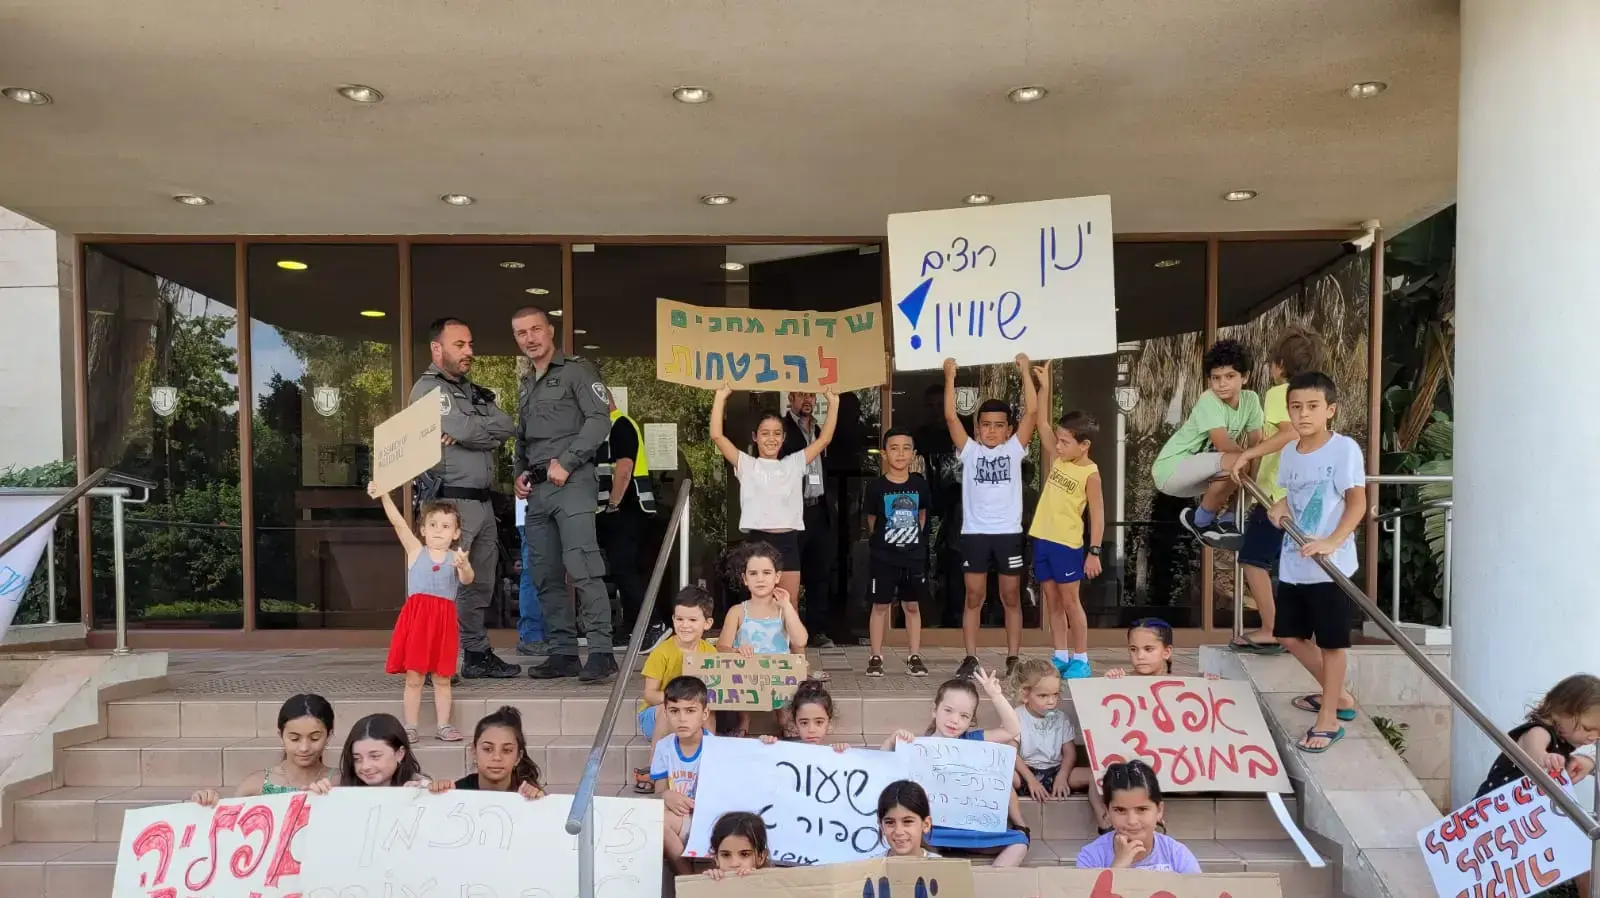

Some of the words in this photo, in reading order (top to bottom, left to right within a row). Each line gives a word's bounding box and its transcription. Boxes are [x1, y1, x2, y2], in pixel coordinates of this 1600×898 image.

[920, 236, 996, 277] רוצים
[671, 309, 765, 333] מחכים
[775, 311, 875, 338] שדות
[979, 468, 1008, 484] SKATE
[700, 656, 745, 669] שדות
[732, 674, 798, 691] מבקשים
[1101, 680, 1248, 735] אפליה
[776, 761, 879, 816] שיעור
[133, 793, 312, 892] אפליה
[359, 802, 514, 867] הזמן
[797, 816, 882, 853] ספור
[1425, 794, 1509, 864] למבנה
[1456, 805, 1547, 881] לעלות
